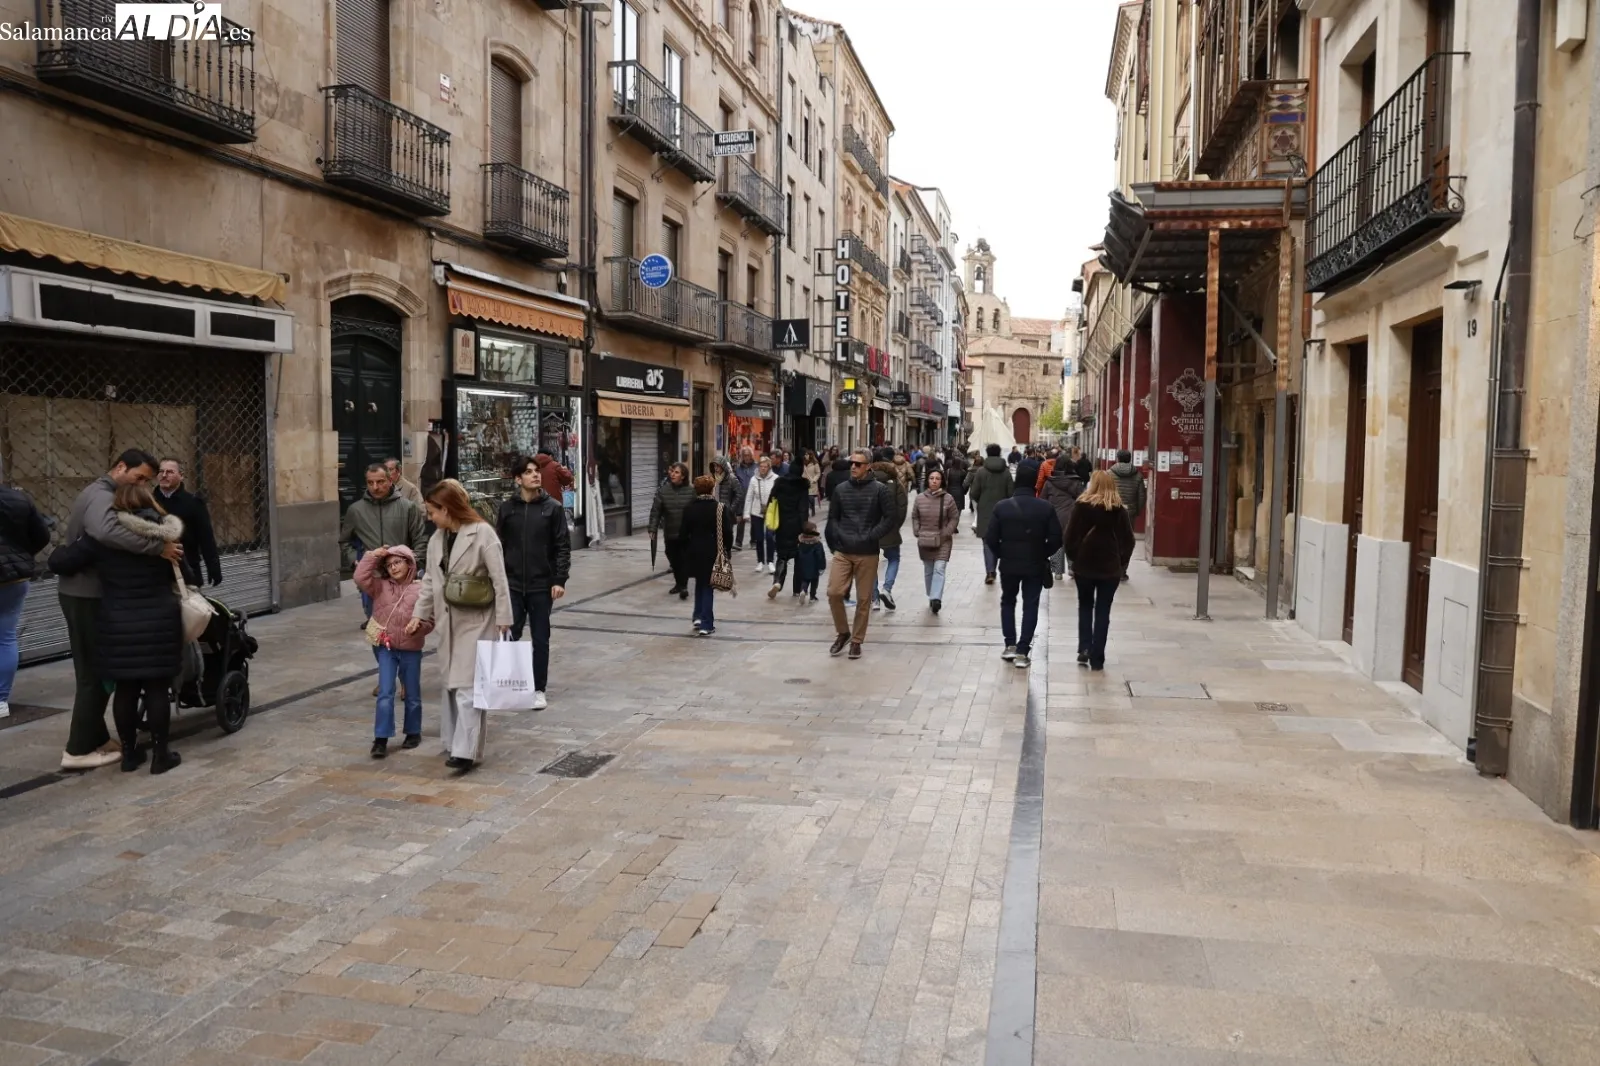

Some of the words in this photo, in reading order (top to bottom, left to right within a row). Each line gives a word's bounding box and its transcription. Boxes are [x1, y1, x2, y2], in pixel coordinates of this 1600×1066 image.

[718, 132, 750, 143] RESIDENCIA
[715, 143, 754, 155] UNIVERSITARIA
[836, 239, 850, 361] HOTEL
[517, 311, 583, 336] REGALOS
[1467, 319, 1477, 338] 19
[615, 375, 644, 390] LIBRERIA
[620, 403, 655, 417] LIBRERIA
[1171, 416, 1204, 426] Semana
[1178, 423, 1204, 433] Santa
